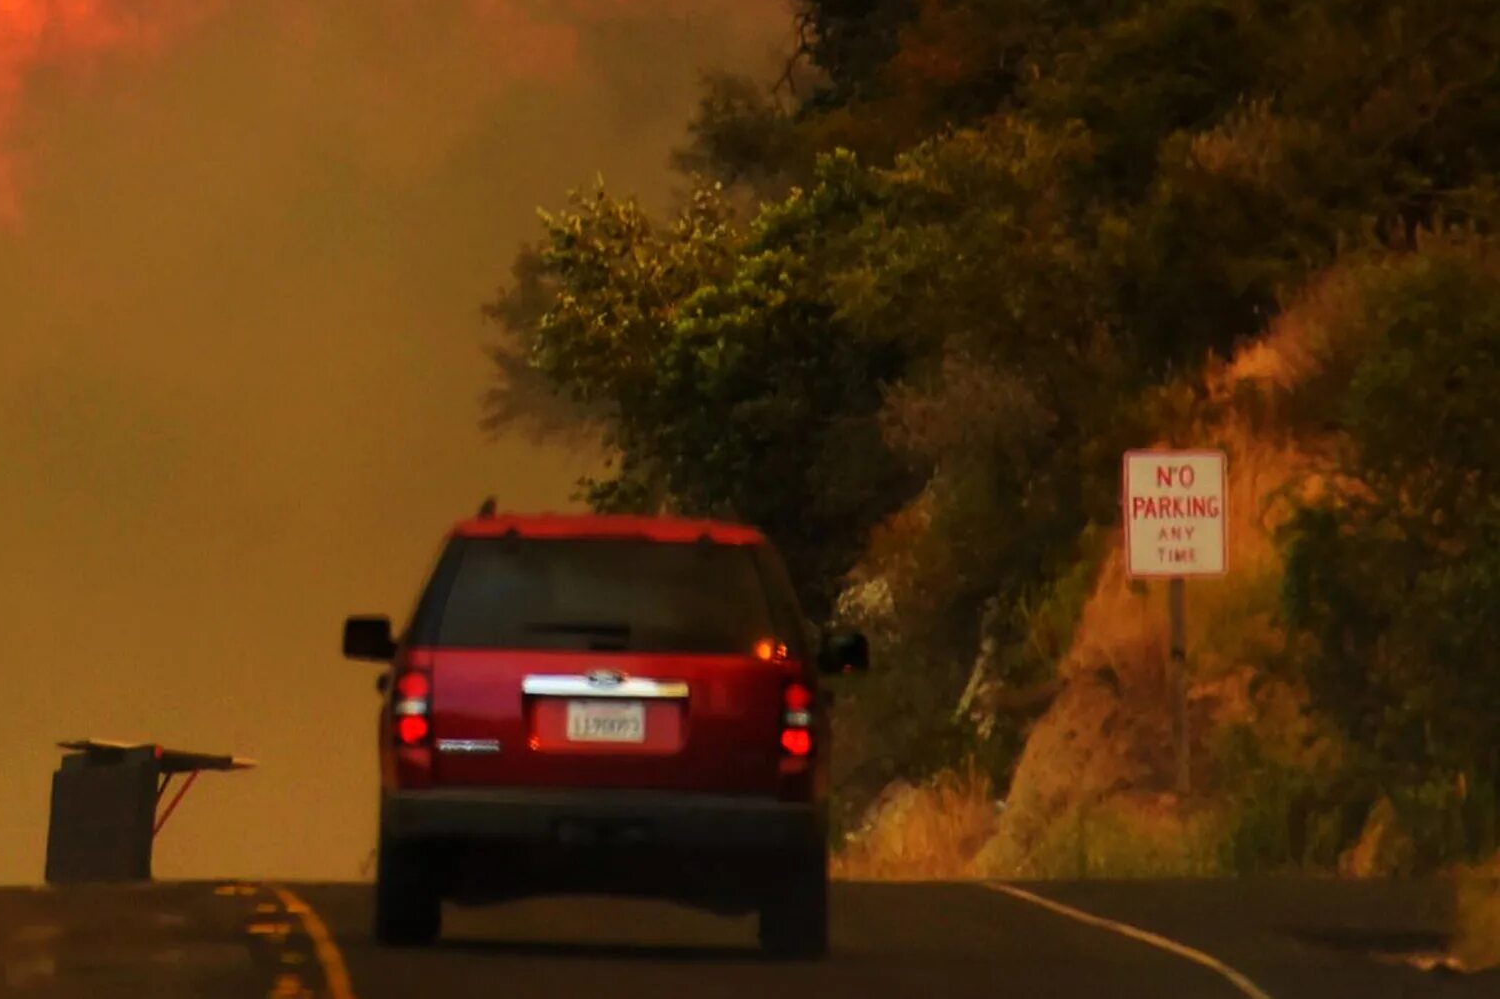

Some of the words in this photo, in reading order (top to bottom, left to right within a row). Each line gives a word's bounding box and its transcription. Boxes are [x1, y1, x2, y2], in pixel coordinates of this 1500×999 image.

[1157, 465, 1195, 488] NO
[1132, 495, 1219, 520] PARKING
[1158, 527, 1194, 541] ANY
[1158, 548, 1195, 563] TIME
